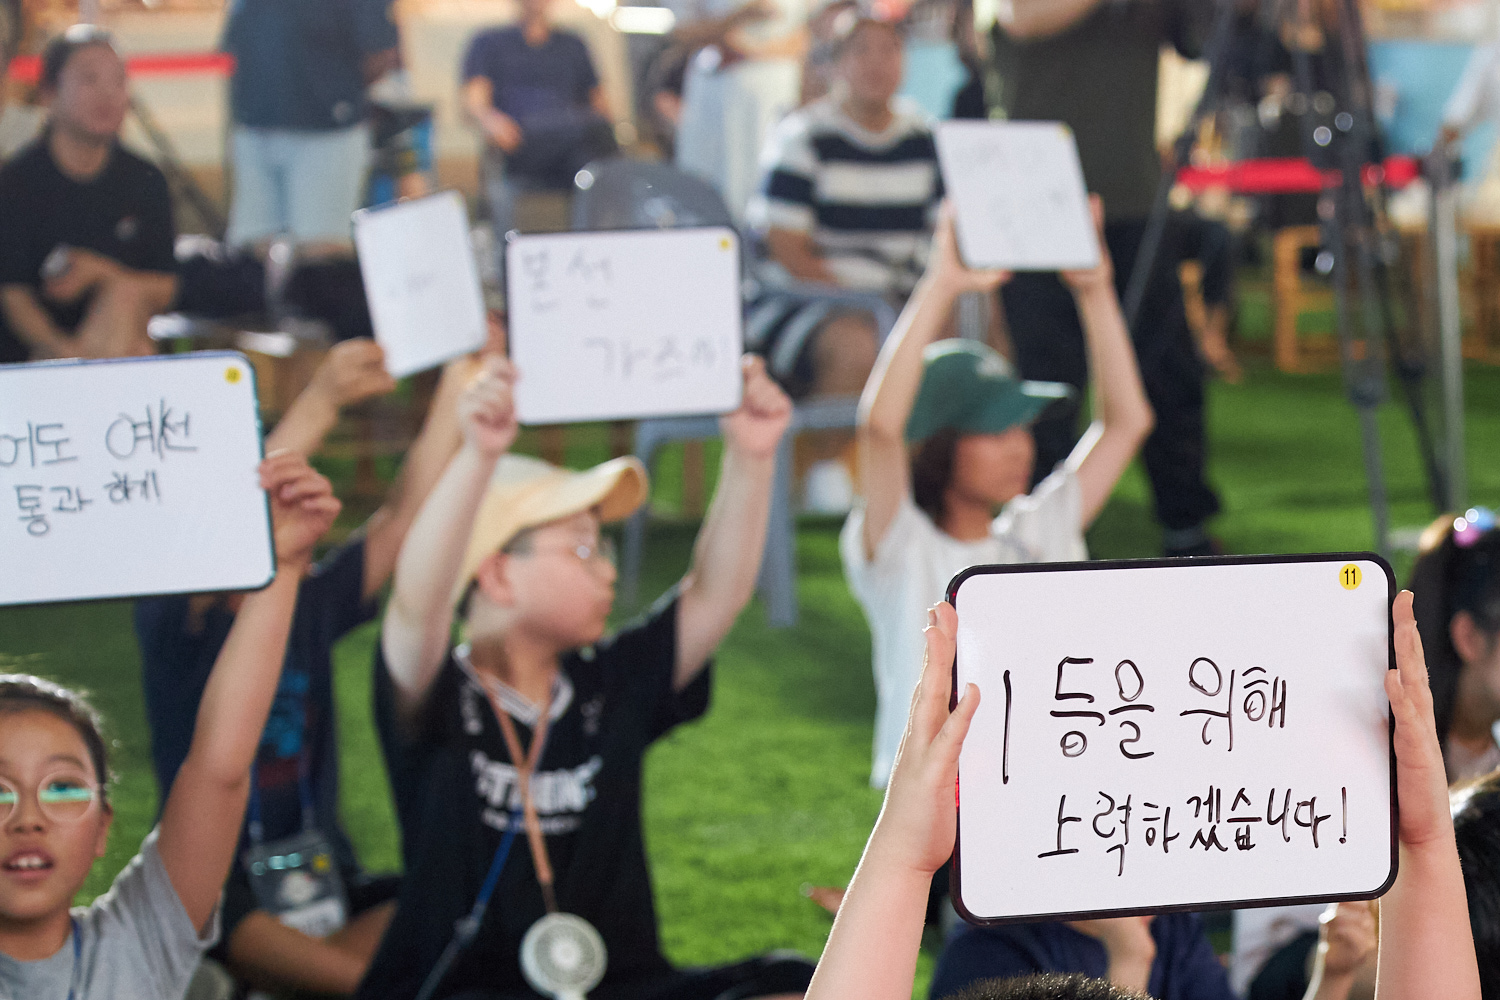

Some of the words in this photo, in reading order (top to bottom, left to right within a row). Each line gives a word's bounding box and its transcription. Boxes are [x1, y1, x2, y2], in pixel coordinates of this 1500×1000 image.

[105, 397, 198, 462] 예선
[1344, 567, 1356, 586] 11
[1003, 669, 1011, 785] 1
[1050, 656, 1155, 760] 등을
[1180, 656, 1287, 752] 위해
[1037, 784, 1348, 878] 노력하겠습니다!
